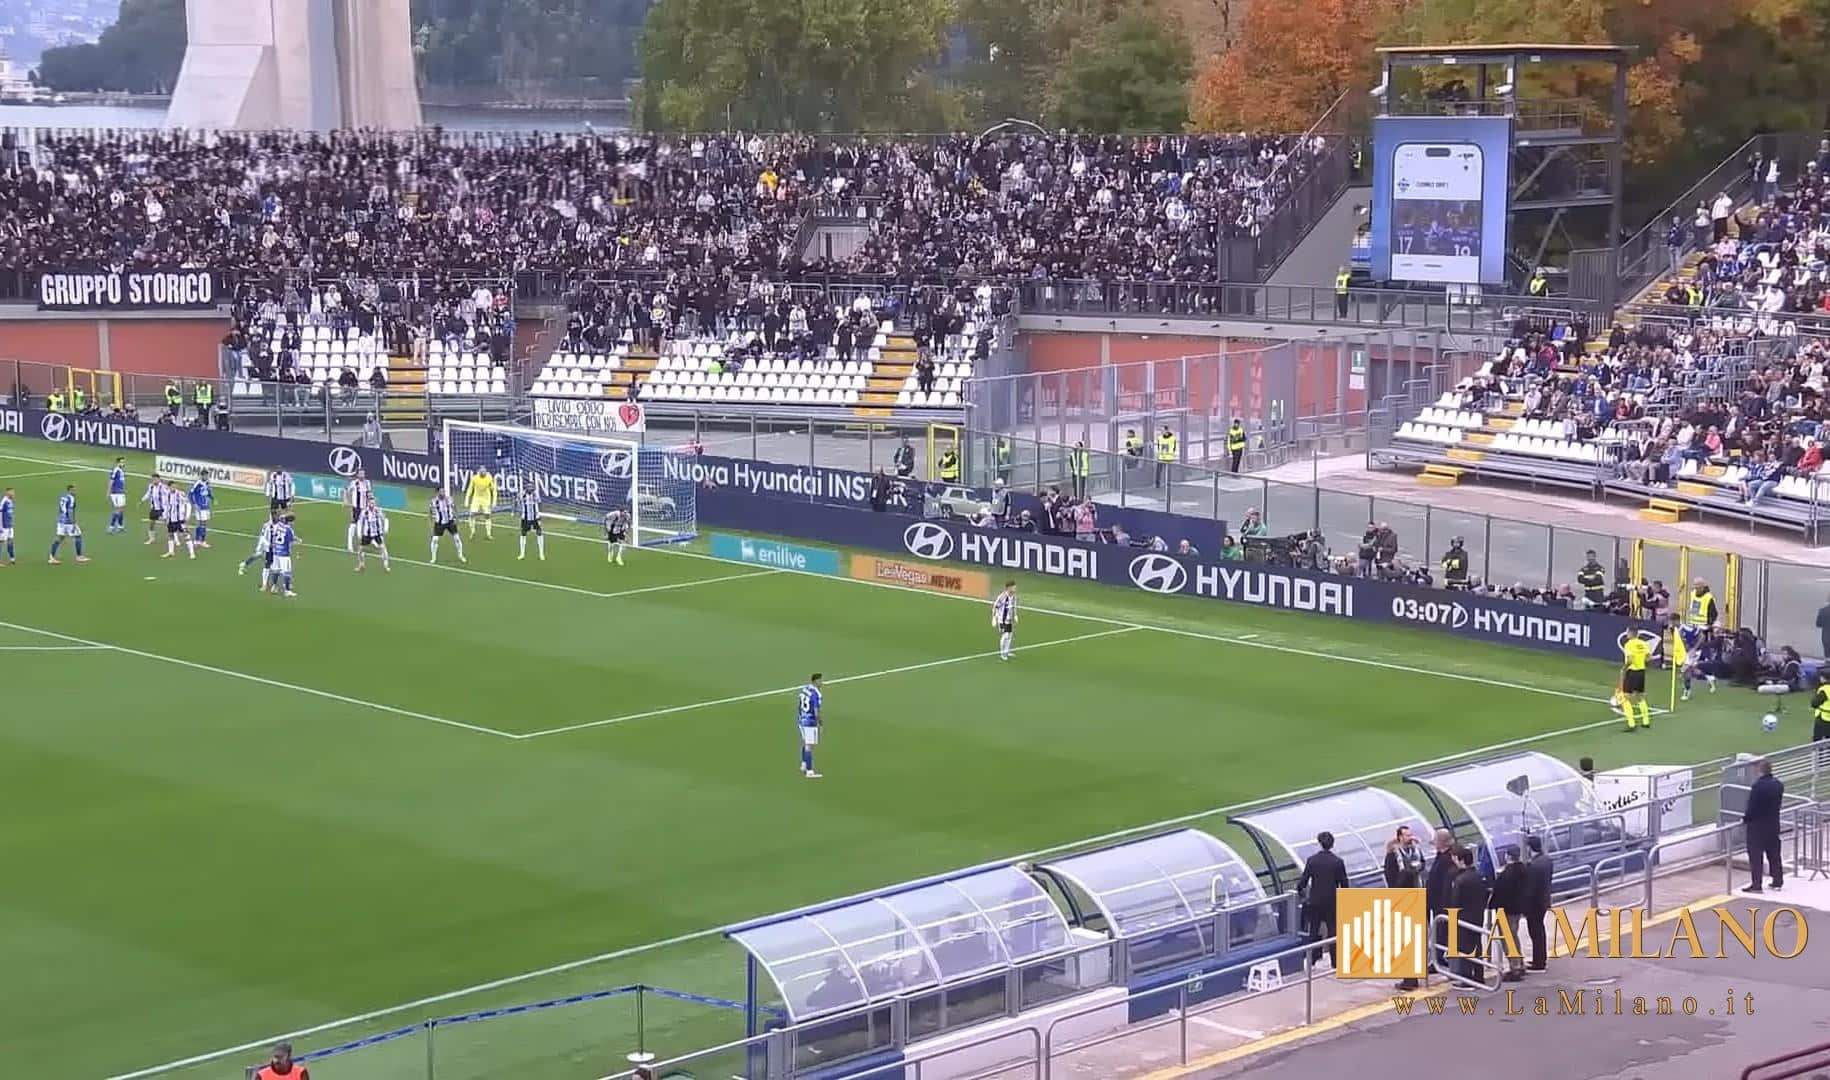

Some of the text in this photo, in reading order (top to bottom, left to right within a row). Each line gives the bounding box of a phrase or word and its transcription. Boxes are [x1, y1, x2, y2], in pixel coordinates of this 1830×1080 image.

[41, 272, 212, 304] GRUPPO STORICO
[75, 419, 156, 450] HYUNDAI
[382, 454, 441, 483] Nuova
[663, 455, 729, 486] Nuova
[734, 462, 823, 497] Hyundai
[760, 546, 806, 569] enilive
[961, 536, 1097, 579] HYUNDAI
[1195, 565, 1353, 616] HYUNDAI
[1392, 597, 1452, 624] 03:07
[1473, 610, 1590, 647] HYUNDAI
